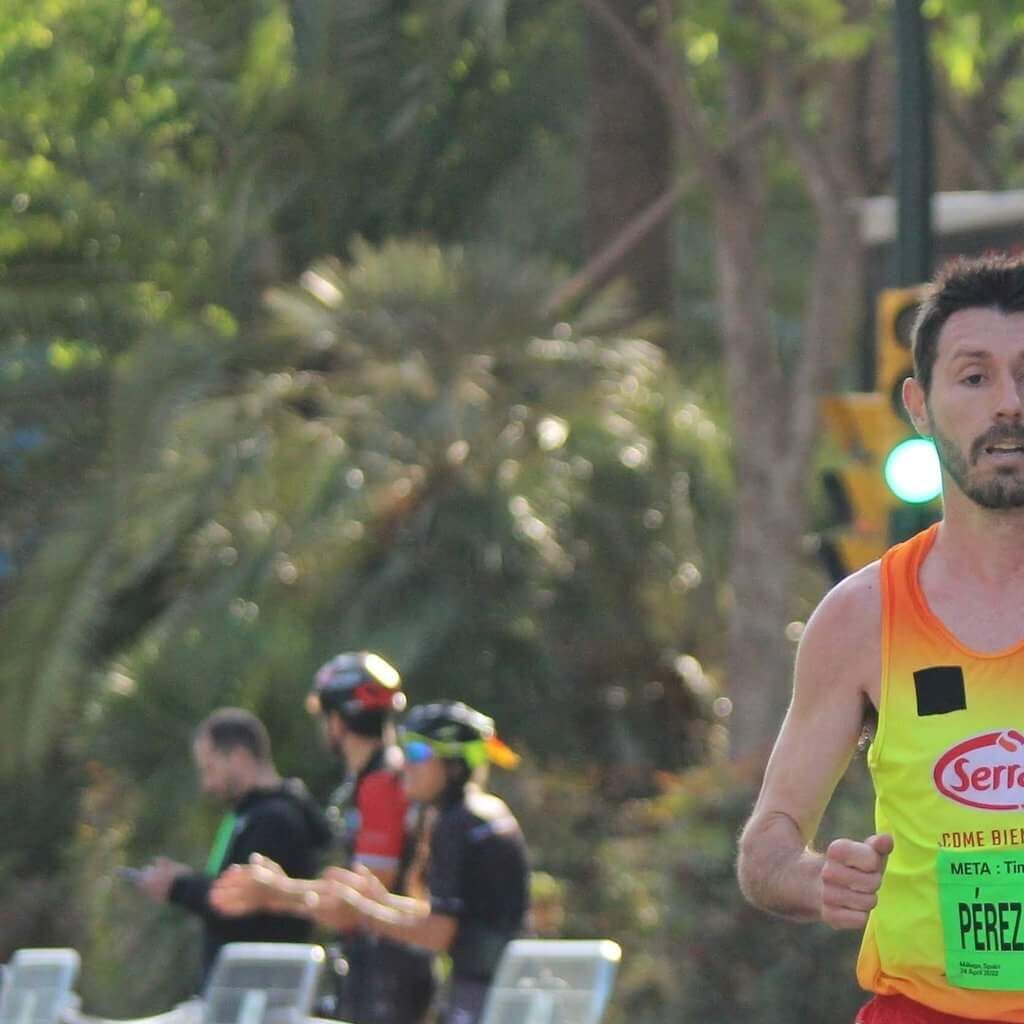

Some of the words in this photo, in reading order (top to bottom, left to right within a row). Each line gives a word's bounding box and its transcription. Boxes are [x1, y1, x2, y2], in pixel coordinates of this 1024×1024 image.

[941, 831, 984, 849] COME
[950, 862, 991, 876] META
[958, 887, 1024, 951] PÉREZ
